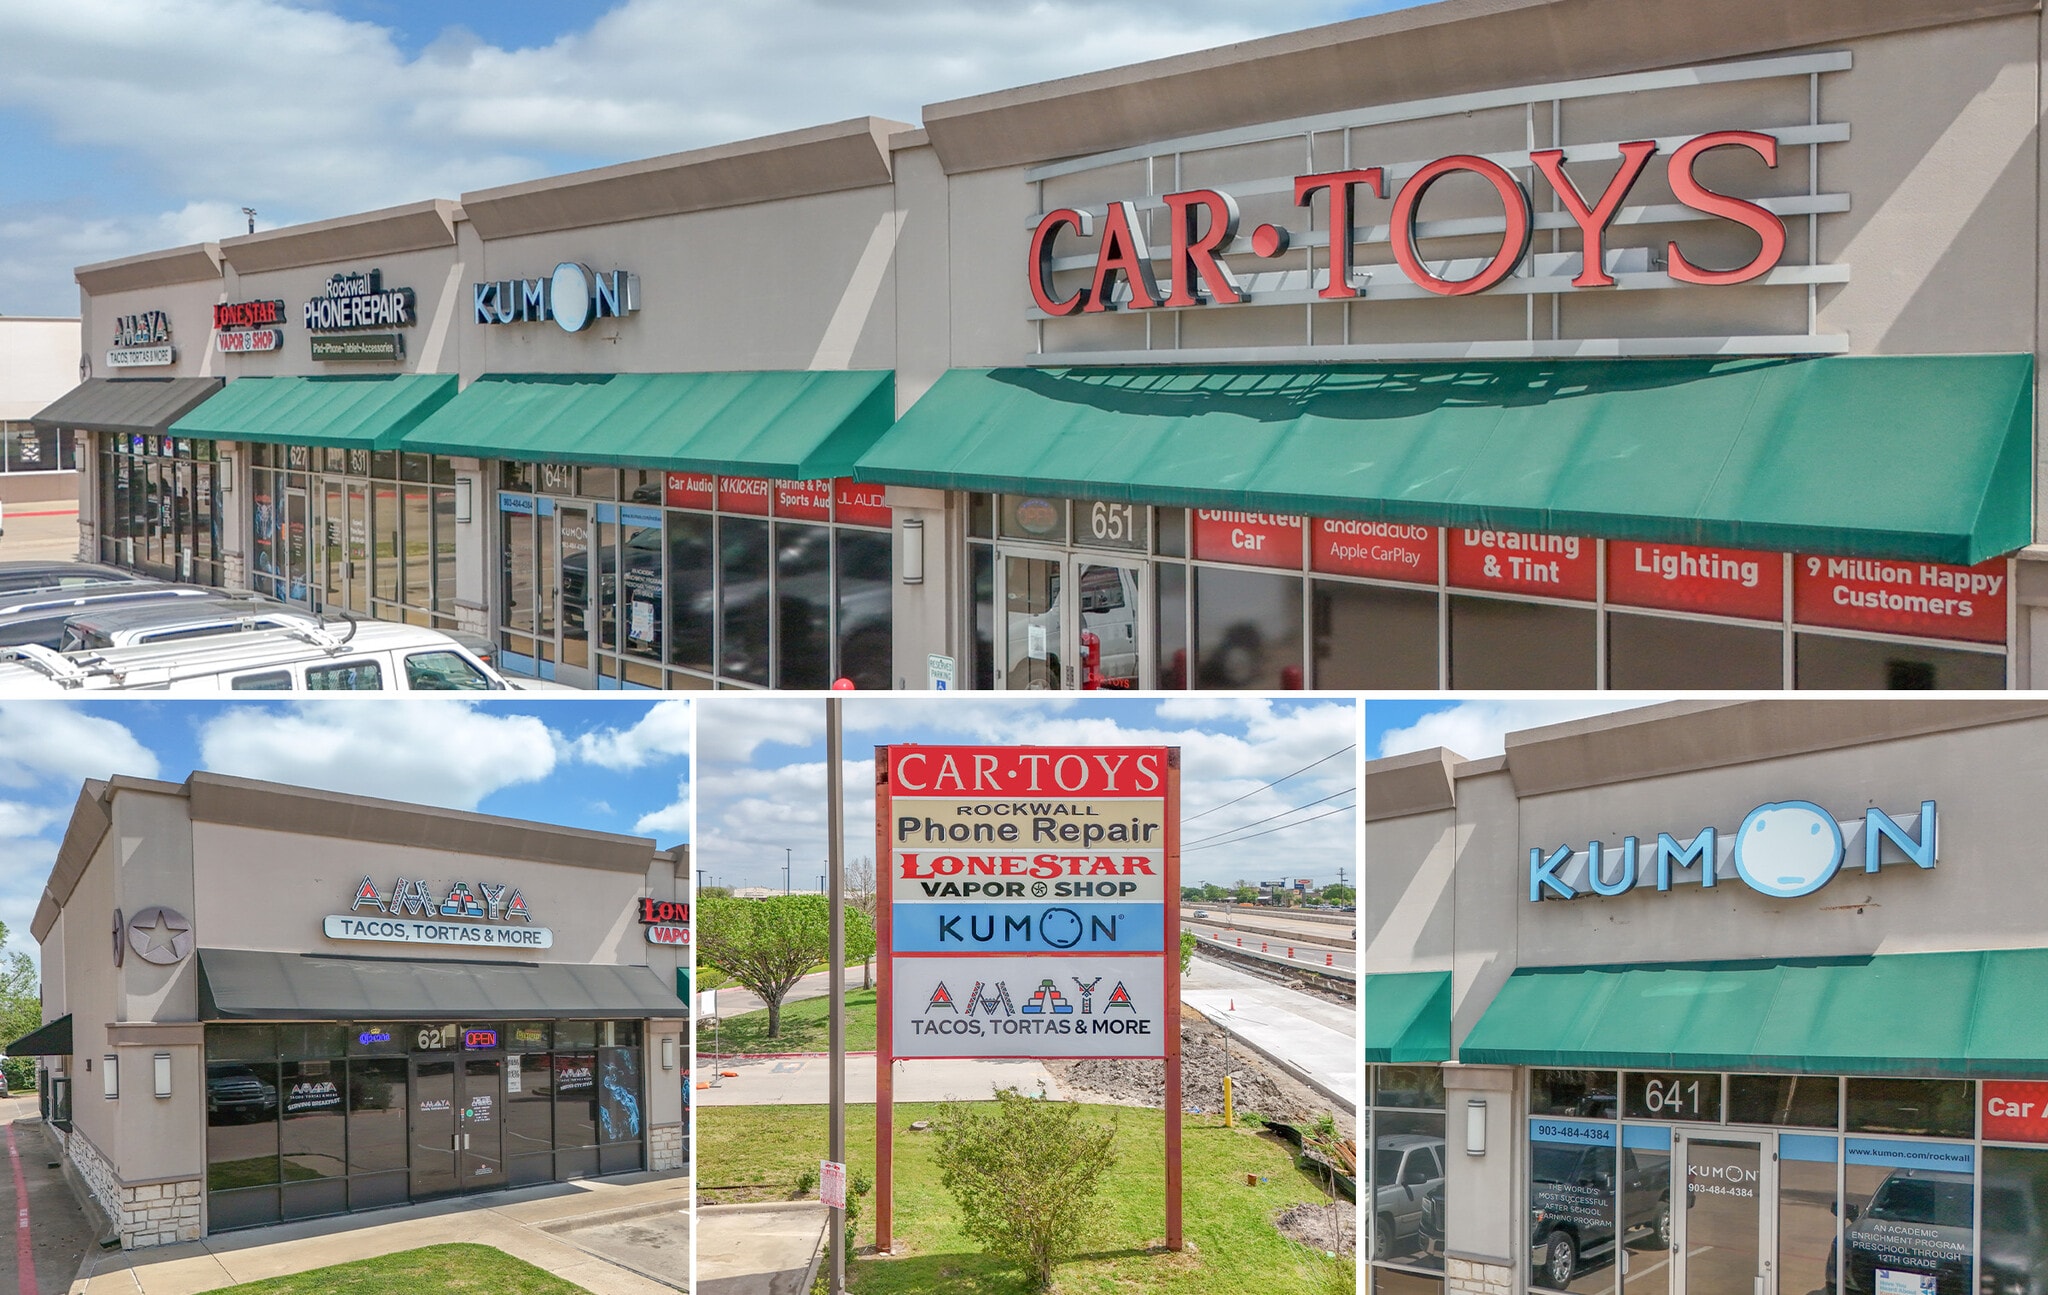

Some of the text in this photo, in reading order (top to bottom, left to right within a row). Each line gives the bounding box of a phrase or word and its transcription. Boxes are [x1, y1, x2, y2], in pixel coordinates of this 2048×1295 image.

[325, 273, 371, 299] Rockwall
[473, 262, 623, 333] KUMON
[219, 330, 273, 350] VAPOR SHOP
[154, 349, 168, 361] MORE
[290, 446, 307, 466] 627
[545, 464, 568, 488] 641
[668, 476, 713, 492] Car Audio
[775, 479, 804, 490] Marine
[807, 480, 814, 491] &
[728, 478, 768, 496] KICKER
[780, 492, 809, 506] Sports
[837, 492, 852, 504] JL
[1091, 501, 1133, 541] 651
[561, 527, 588, 540] KUMON
[1231, 528, 1266, 550] Car
[1464, 528, 1579, 560] Detailing
[1330, 542, 1420, 568] Apple CarPlay
[1483, 554, 1560, 583] & Tint
[1634, 548, 1759, 587] Lighting
[1806, 557, 2003, 596] 9 Million Happy
[1832, 586, 1974, 617] Customers
[929, 659, 953, 672] RESERVED
[930, 670, 951, 681] PARKING
[956, 803, 1099, 816] ROCKWALL
[898, 817, 1159, 848] Phone Repair
[1529, 799, 1937, 903] KUMON
[350, 873, 532, 923] AMAYA
[920, 881, 1137, 897] VAPOR SHOP
[340, 920, 542, 944] TACOS, TORTAS & MORE
[924, 976, 1137, 1017] AMAYA
[911, 1019, 1151, 1037] TACOS, TORTAS & MORE
[418, 1029, 447, 1049] 621
[467, 1032, 495, 1045] OPEN
[311, 1097, 341, 1107] BREAKFAST
[1645, 1079, 1700, 1114] 641
[1987, 1097, 2035, 1118] Car
[1538, 1125, 1610, 1140] 903-484-4384
[1848, 1148, 1970, 1163] www.kumon.com/rockwall
[1548, 1183, 1601, 1196] THE WORLD'S
[1688, 1183, 1753, 1198] 903-484-4384
[1538, 1192, 1609, 1207] MOST SUCCESSFUL
[1544, 1203, 1602, 1216] AFTER SCHOOL
[1573, 1216, 1612, 1227] PROGRAM
[1873, 1223, 1939, 1238] AN ACADEMIC
[1851, 1231, 1966, 1251] ENRICHMENT PROGRAM
[1852, 1240, 1961, 1262] PRESCHOOL THROUGH
[1877, 1253, 1937, 1268] 12TH GRADE
